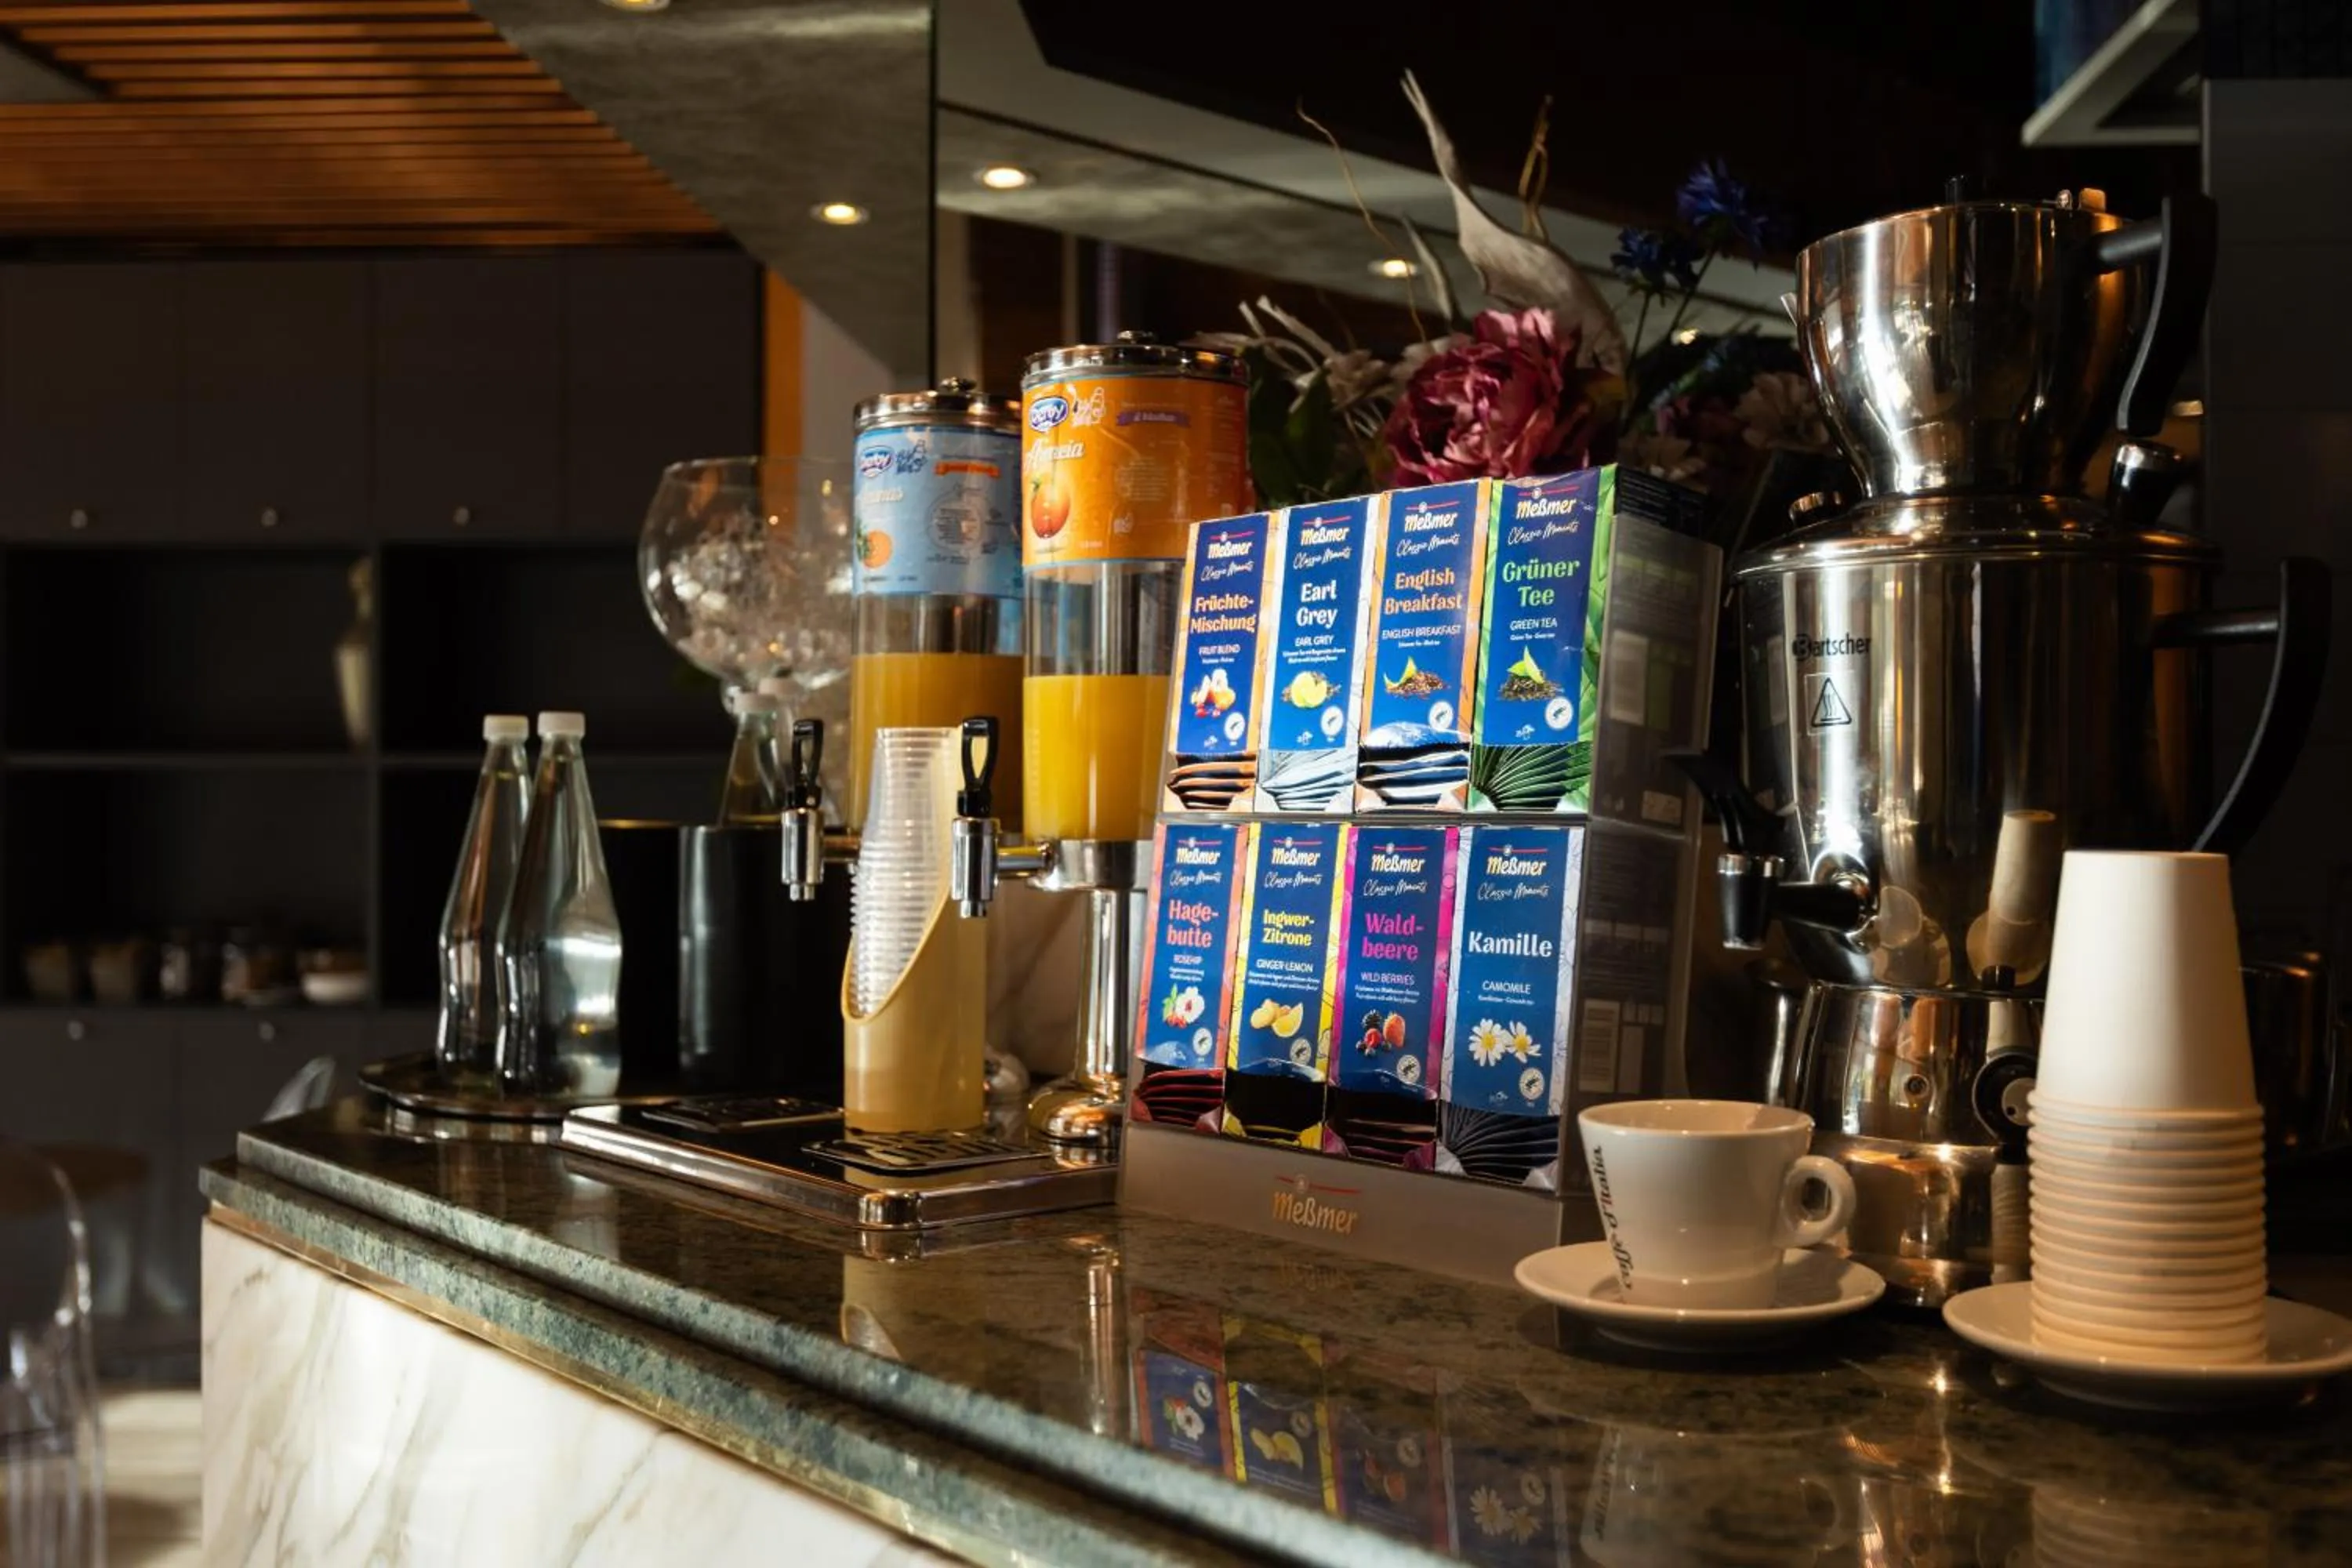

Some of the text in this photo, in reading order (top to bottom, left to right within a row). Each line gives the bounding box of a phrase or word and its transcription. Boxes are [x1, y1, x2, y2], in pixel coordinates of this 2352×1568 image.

[1515, 498, 1576, 519] Meßmer
[1404, 511, 1457, 532] Meßmer
[1301, 527, 1349, 546] Meßmer
[1207, 541, 1252, 558] Meßmer
[1395, 567, 1455, 591] English
[1502, 558, 1581, 583] Grüner
[1301, 579, 1337, 603] Earl
[1517, 586, 1555, 608] Tee
[1195, 593, 1254, 612] Früchte-
[1384, 593, 1462, 615] Breakfast
[1190, 614, 1256, 634] Mischung
[1296, 607, 1338, 630] Grey
[1510, 617, 1558, 630] GREEN TEA
[1295, 635, 1334, 647] EARL GREY
[1381, 624, 1461, 640] ENGLISH BREAKFAST
[1792, 632, 1871, 661] Bartscher
[1176, 848, 1221, 866] Meßmer
[1272, 848, 1320, 866] Meßmer
[1372, 854, 1425, 873] Meßmer
[1486, 855, 1547, 877] Meßmer
[1168, 899, 1219, 926] Hage-
[1262, 909, 1315, 928] Ingwer-
[1365, 913, 1425, 937] Wald-
[1167, 924, 1212, 948] butte
[1261, 927, 1312, 947] Zitrone
[1468, 931, 1554, 958] Kamille
[1361, 937, 1418, 960] beere
[1361, 972, 1415, 985] WILD BERRIES
[1483, 979, 1531, 995] CAMOMILE
[1272, 1191, 1358, 1234] Meßmer
